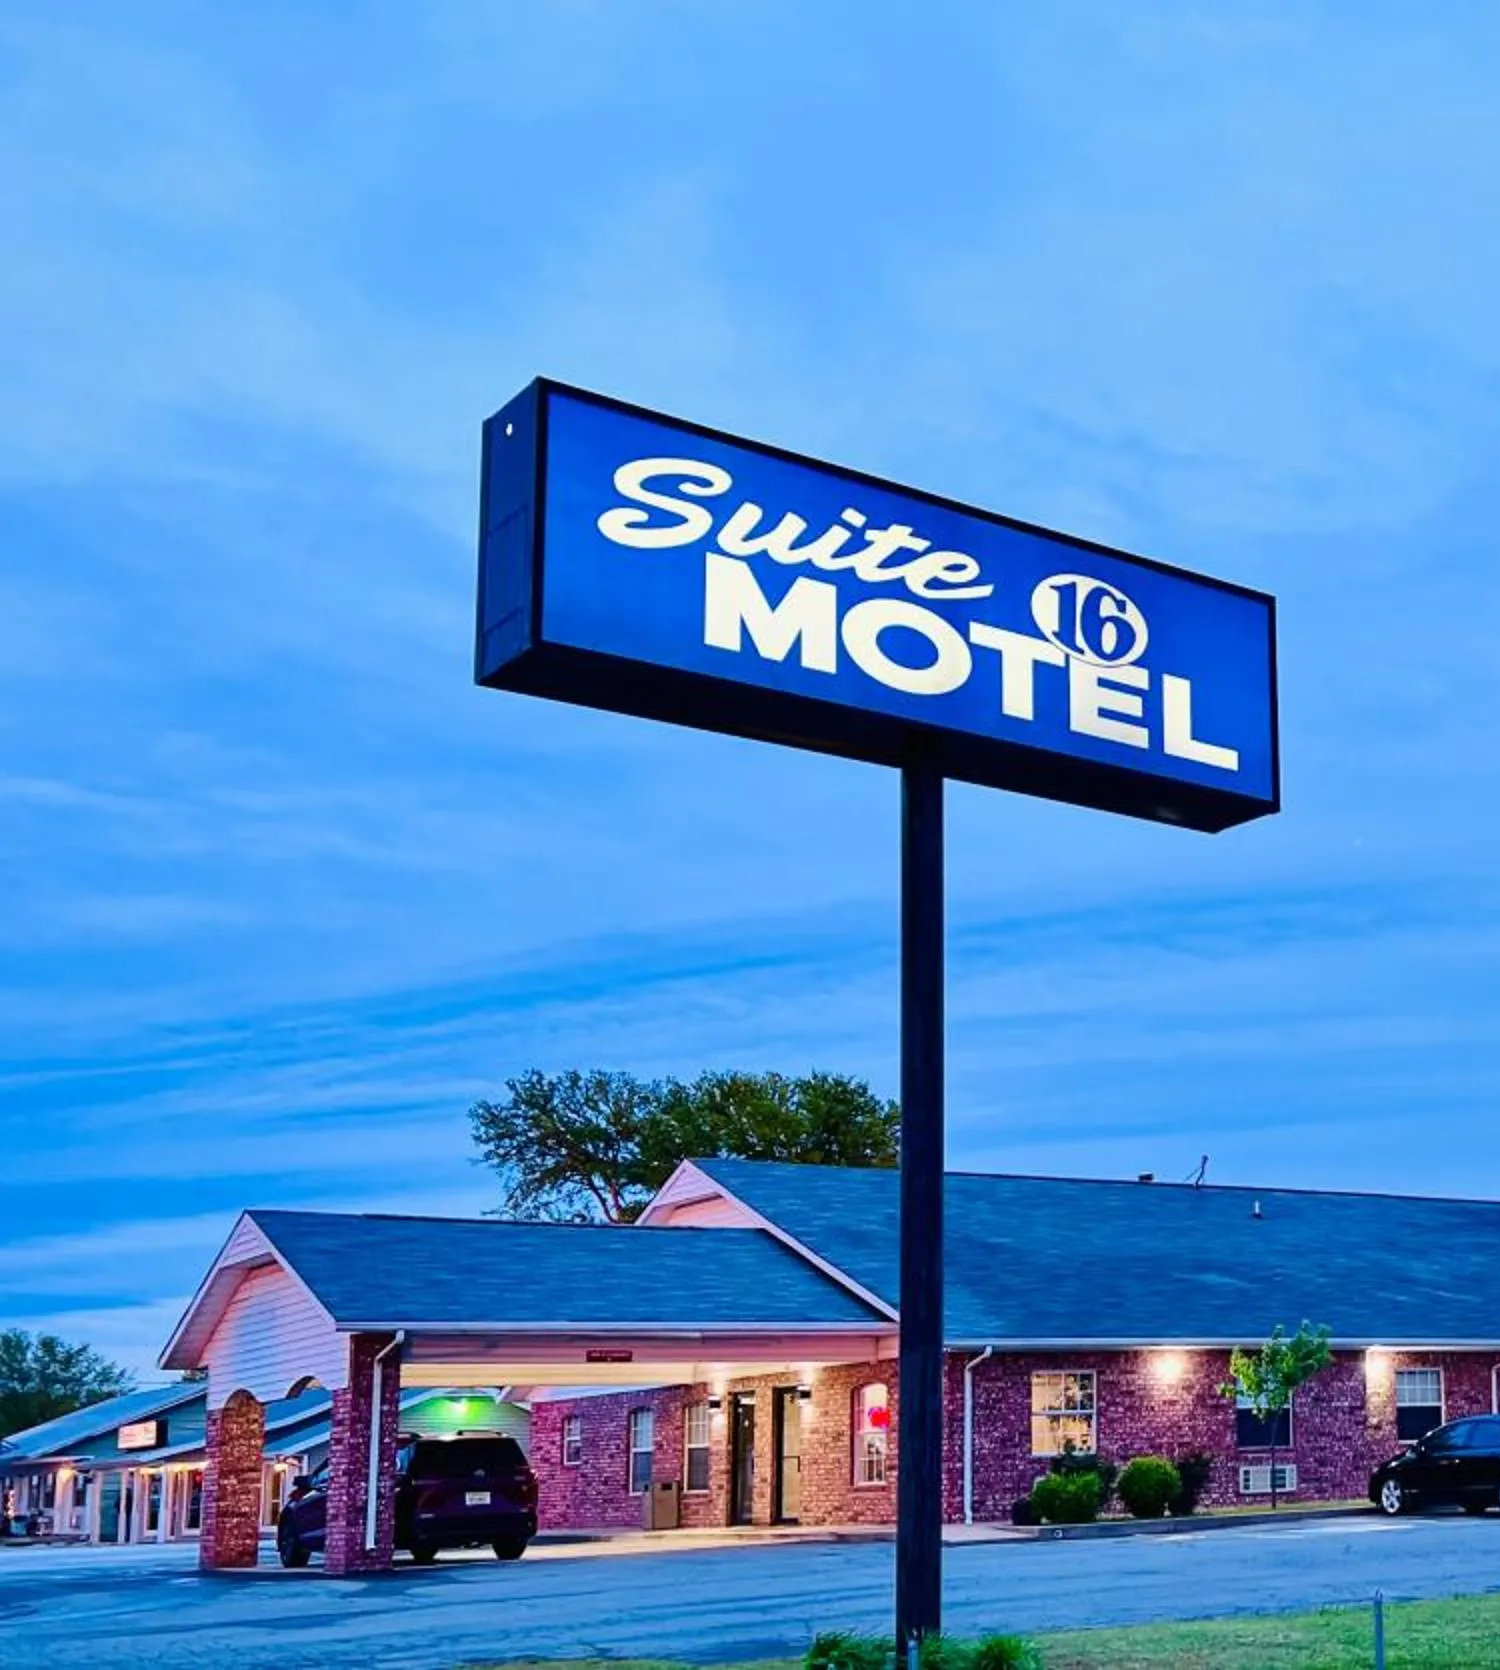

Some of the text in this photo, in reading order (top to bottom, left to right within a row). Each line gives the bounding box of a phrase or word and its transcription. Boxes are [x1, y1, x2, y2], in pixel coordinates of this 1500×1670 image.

[597, 457, 1137, 662] Suite 16
[704, 552, 1239, 771] MOTEL
